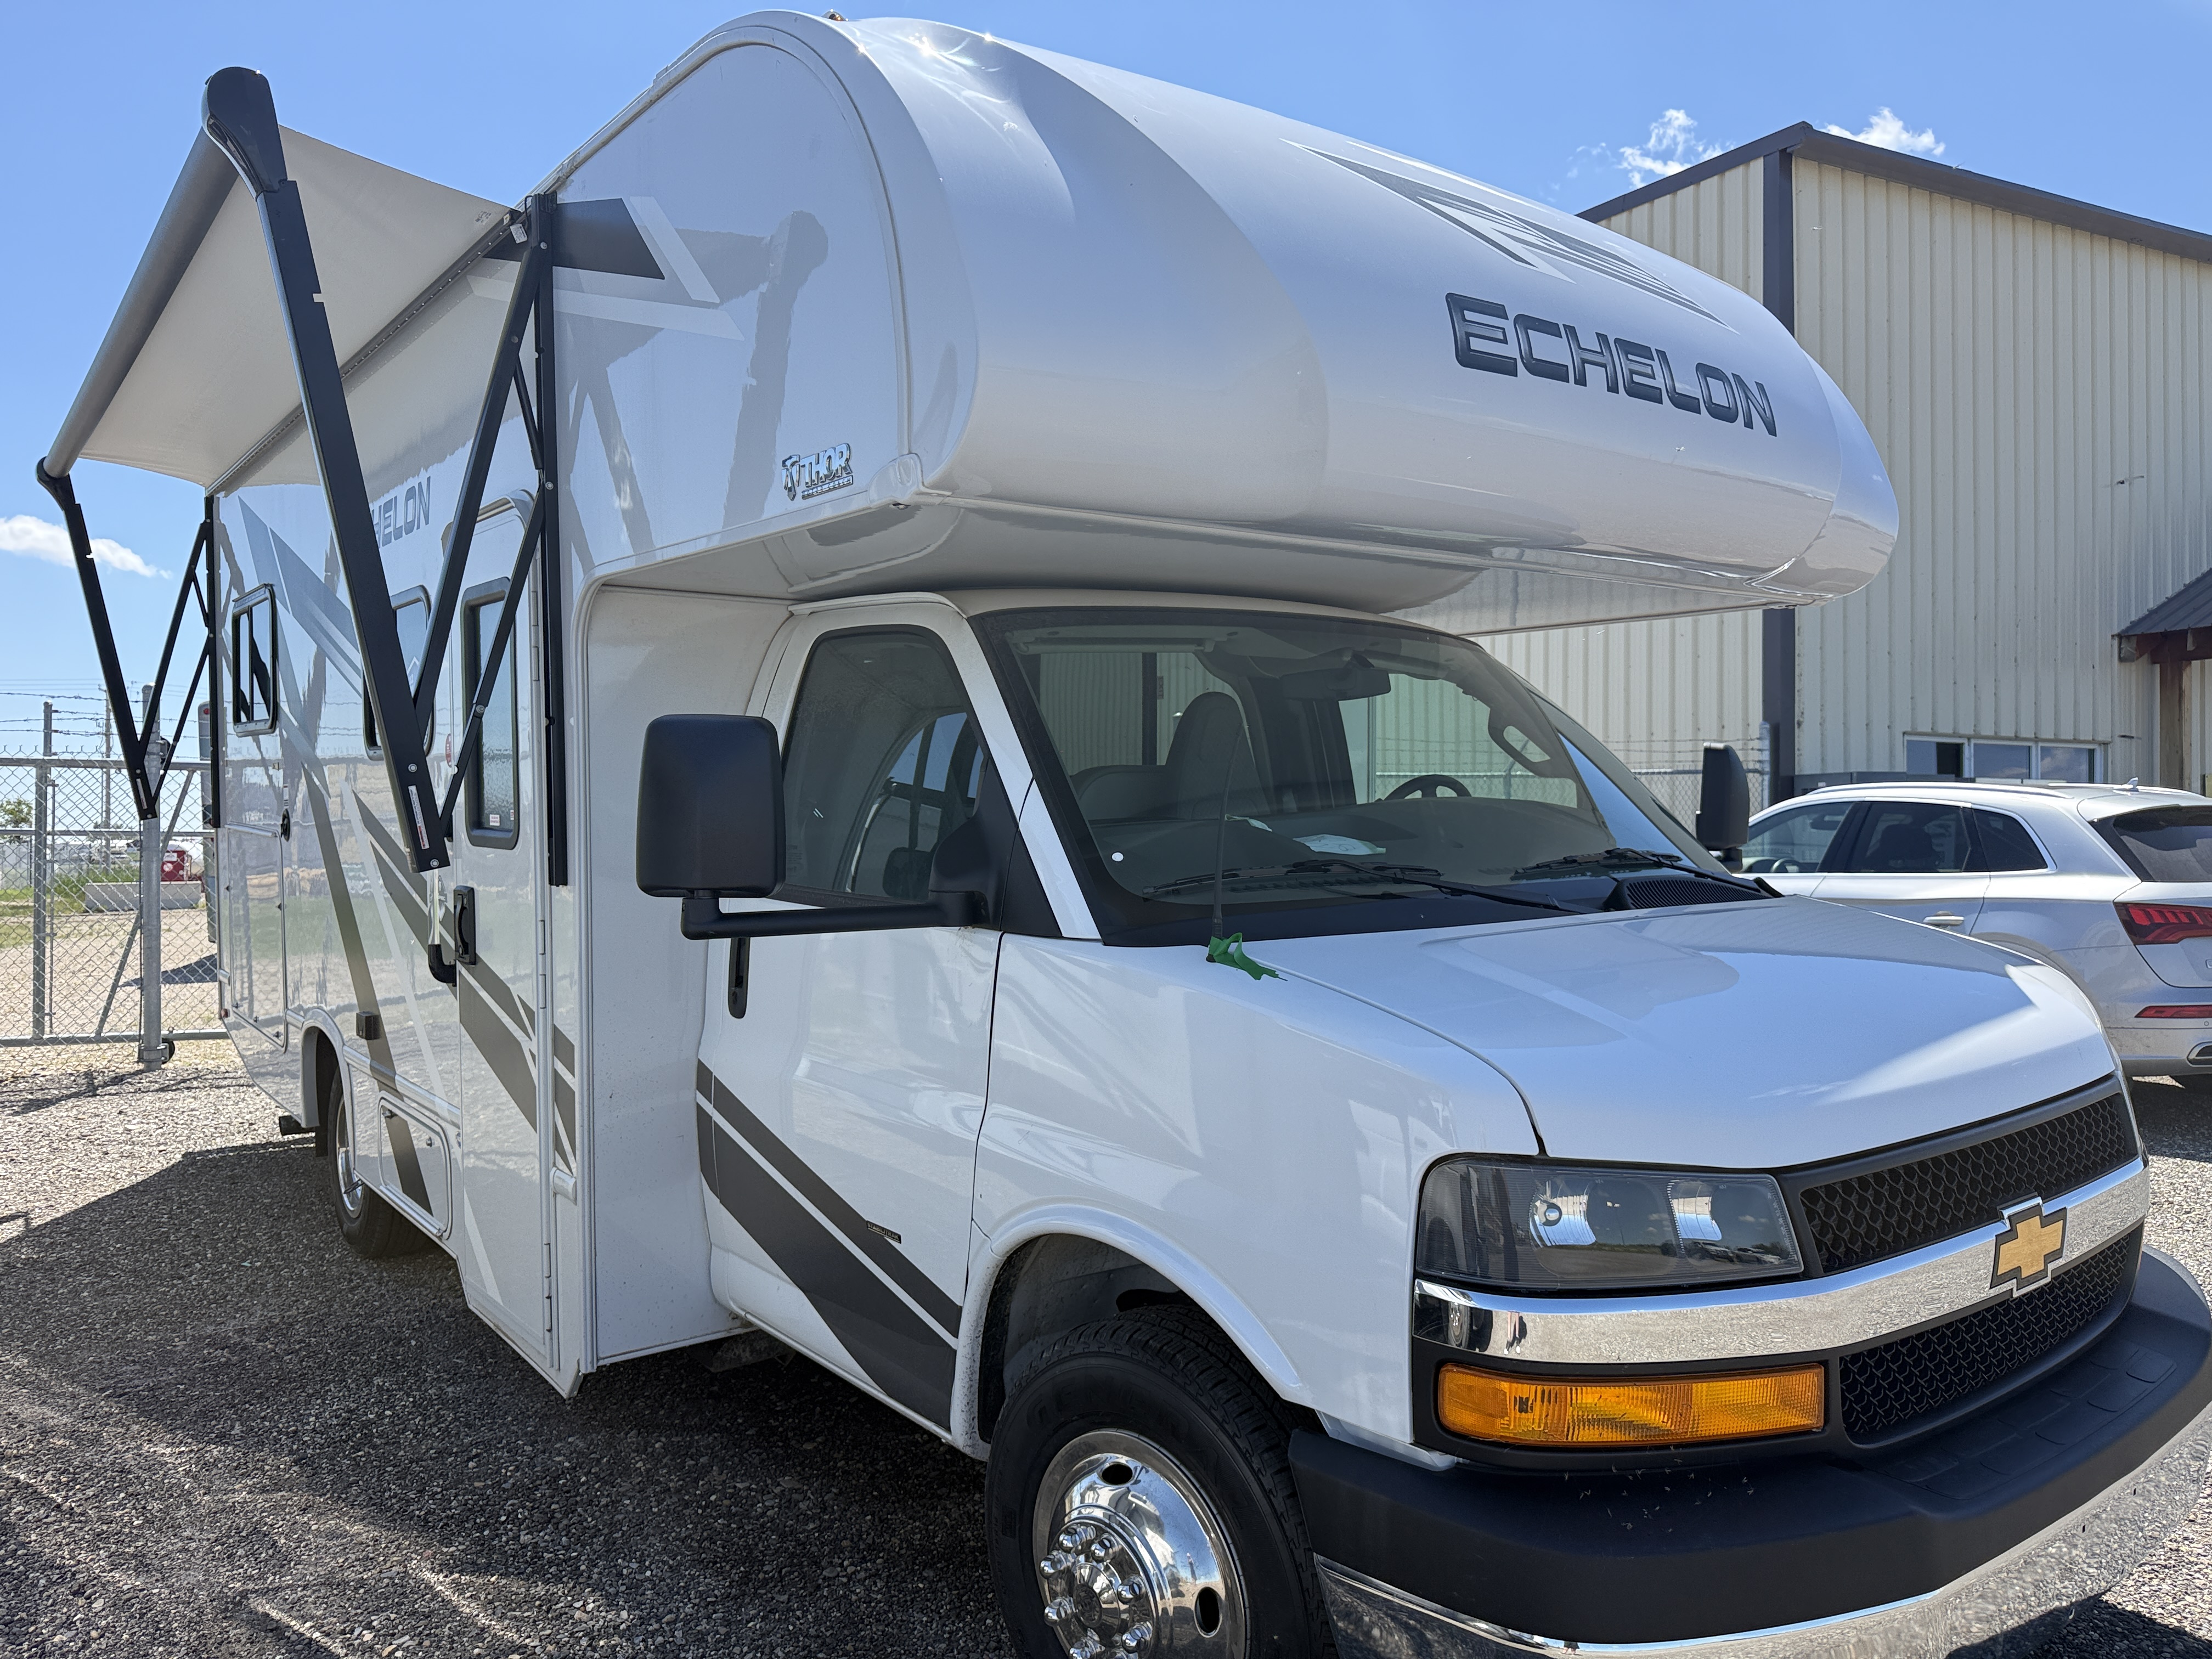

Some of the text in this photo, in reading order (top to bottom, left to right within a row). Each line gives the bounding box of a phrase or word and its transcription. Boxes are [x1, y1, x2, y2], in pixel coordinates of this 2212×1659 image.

[1445, 292, 1777, 437] ECHELON
[800, 443, 853, 488] THOR
[371, 476, 431, 548] HELON
